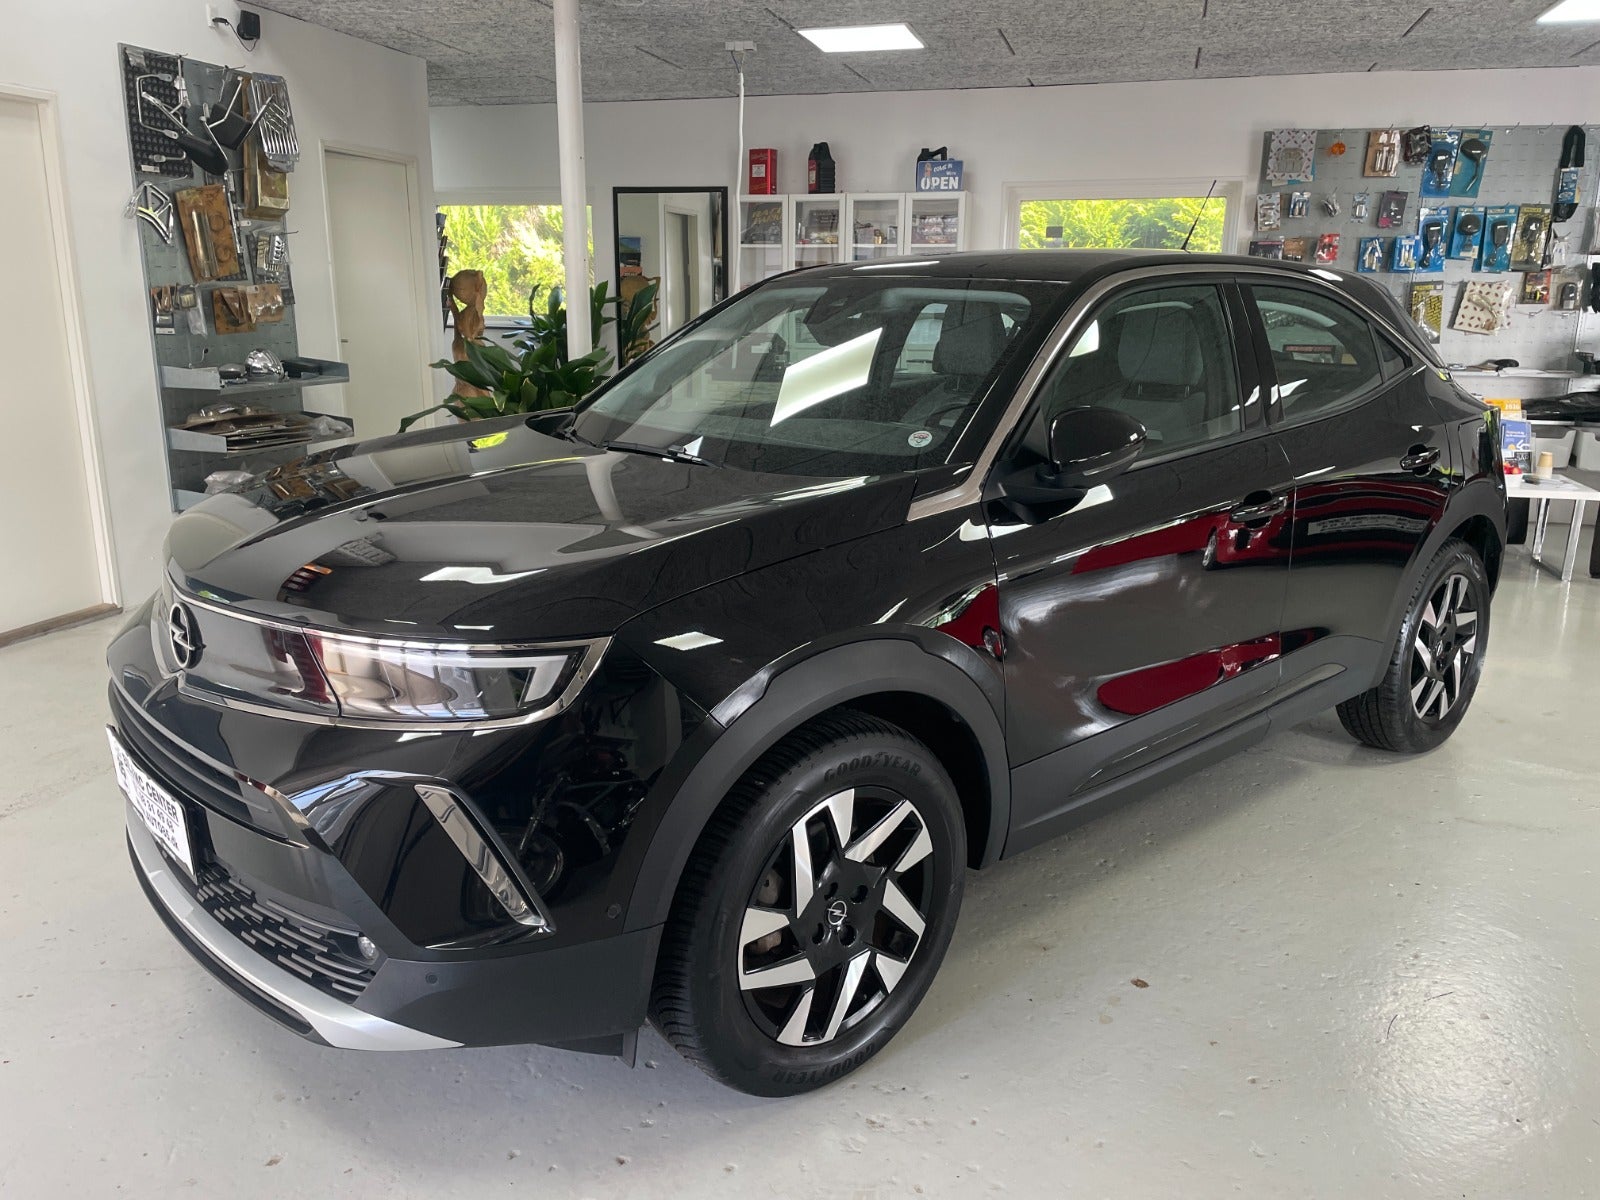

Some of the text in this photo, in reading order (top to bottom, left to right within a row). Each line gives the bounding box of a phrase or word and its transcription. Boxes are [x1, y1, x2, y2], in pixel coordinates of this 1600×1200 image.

[920, 176, 959, 190] OPEN
[823, 752, 921, 782] GOODYEAR
[146, 782, 179, 823] CENTER
